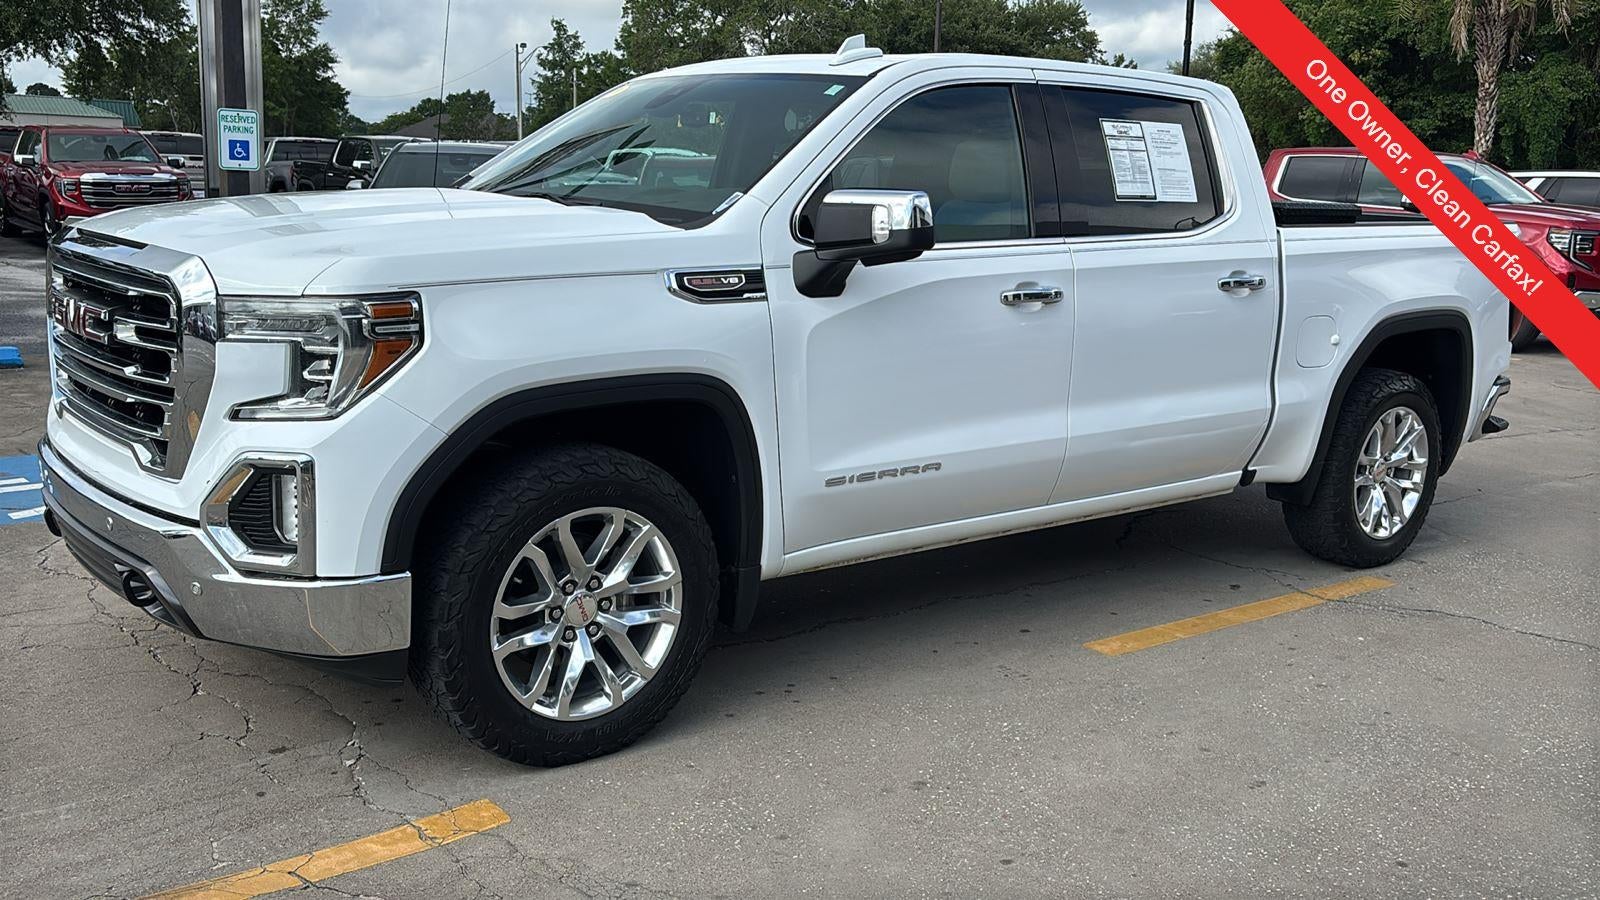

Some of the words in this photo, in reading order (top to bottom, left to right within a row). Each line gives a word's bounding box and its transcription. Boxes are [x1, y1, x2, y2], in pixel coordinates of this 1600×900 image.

[220, 114, 256, 125] RESERVED
[223, 125, 254, 135] PARKING
[52, 297, 109, 344] GMC
[824, 462, 942, 488] SIERRA
